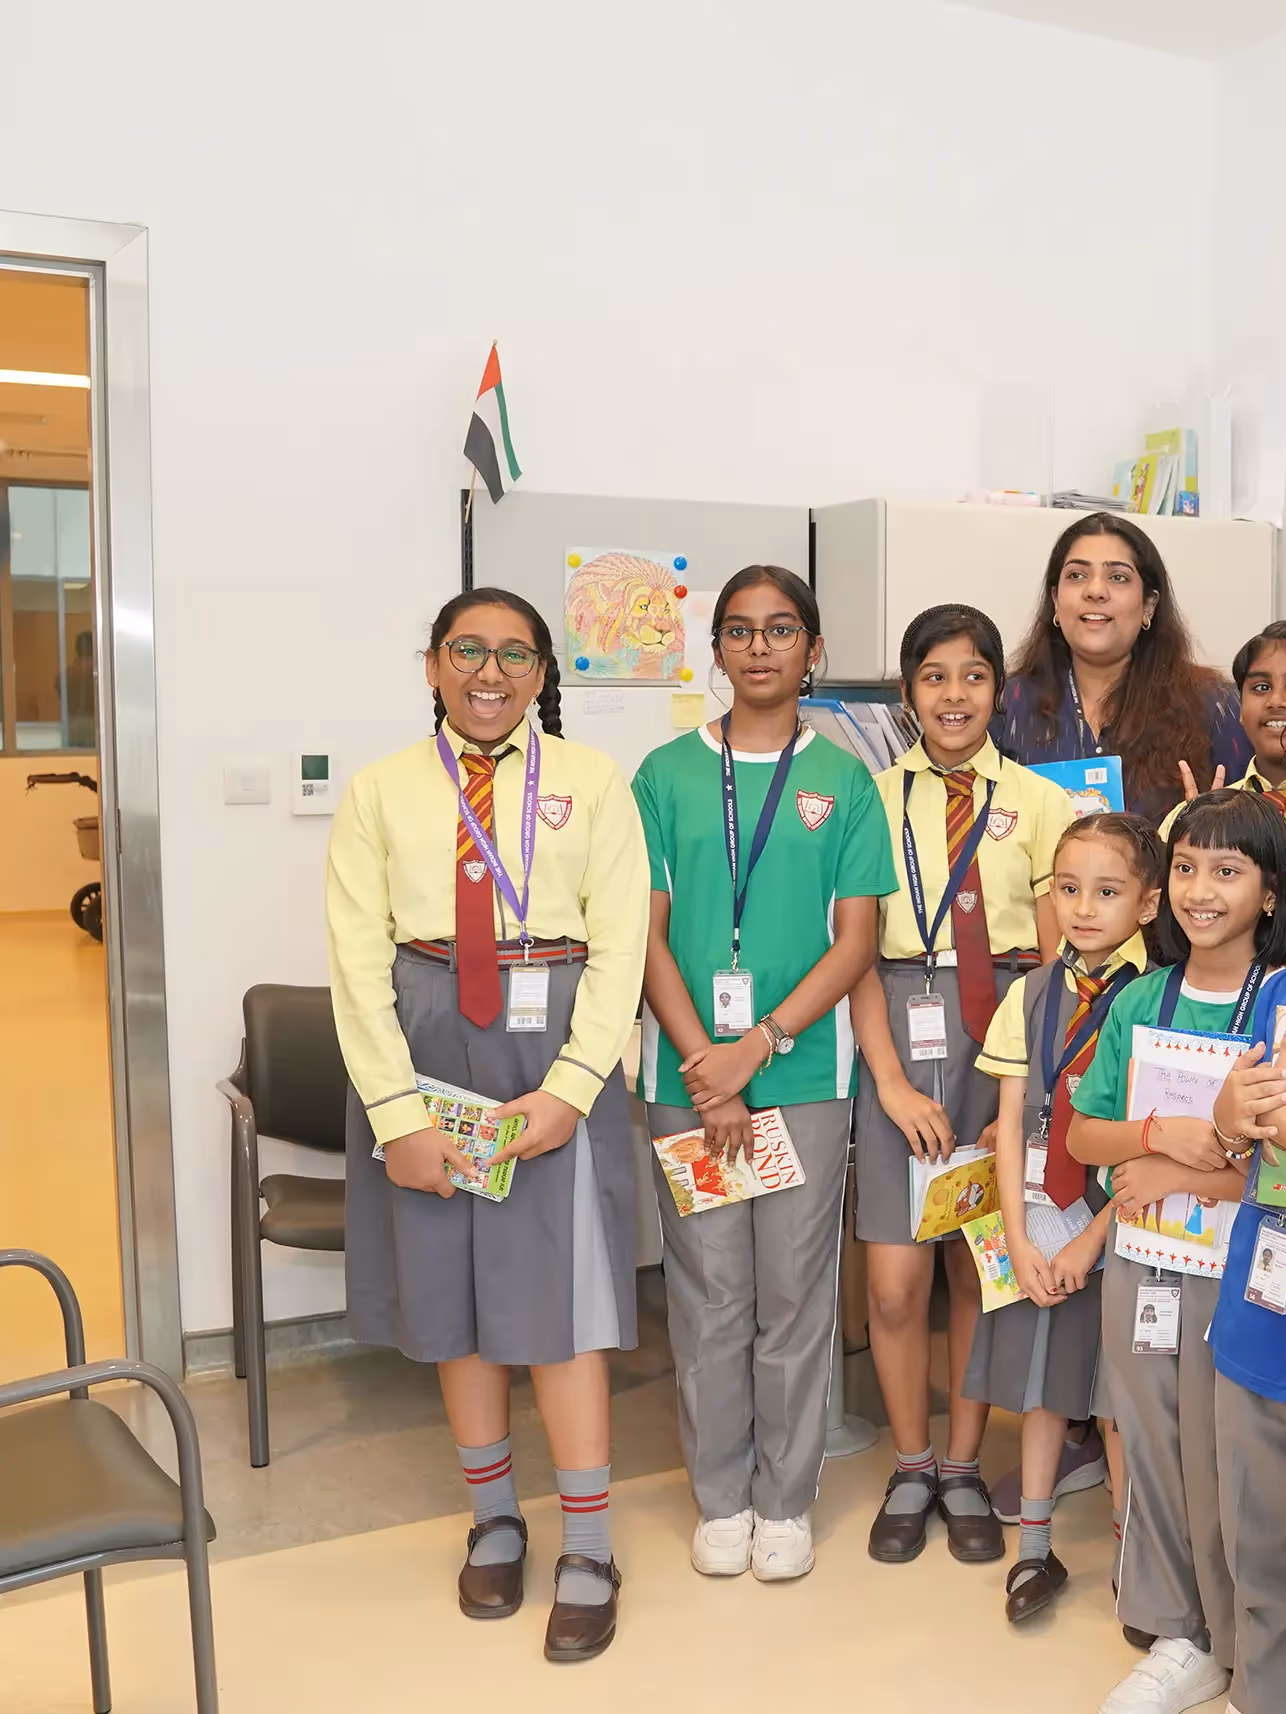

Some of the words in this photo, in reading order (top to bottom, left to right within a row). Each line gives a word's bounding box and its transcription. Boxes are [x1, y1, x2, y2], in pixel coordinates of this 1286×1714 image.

[908, 856, 916, 873] GROUP
[1234, 1011, 1244, 1026] HIGH
[1240, 992, 1251, 1011] GROUP
[1247, 984, 1253, 992] OF
[1154, 1066, 1171, 1080] The
[761, 1114, 800, 1184] RUSKIN
